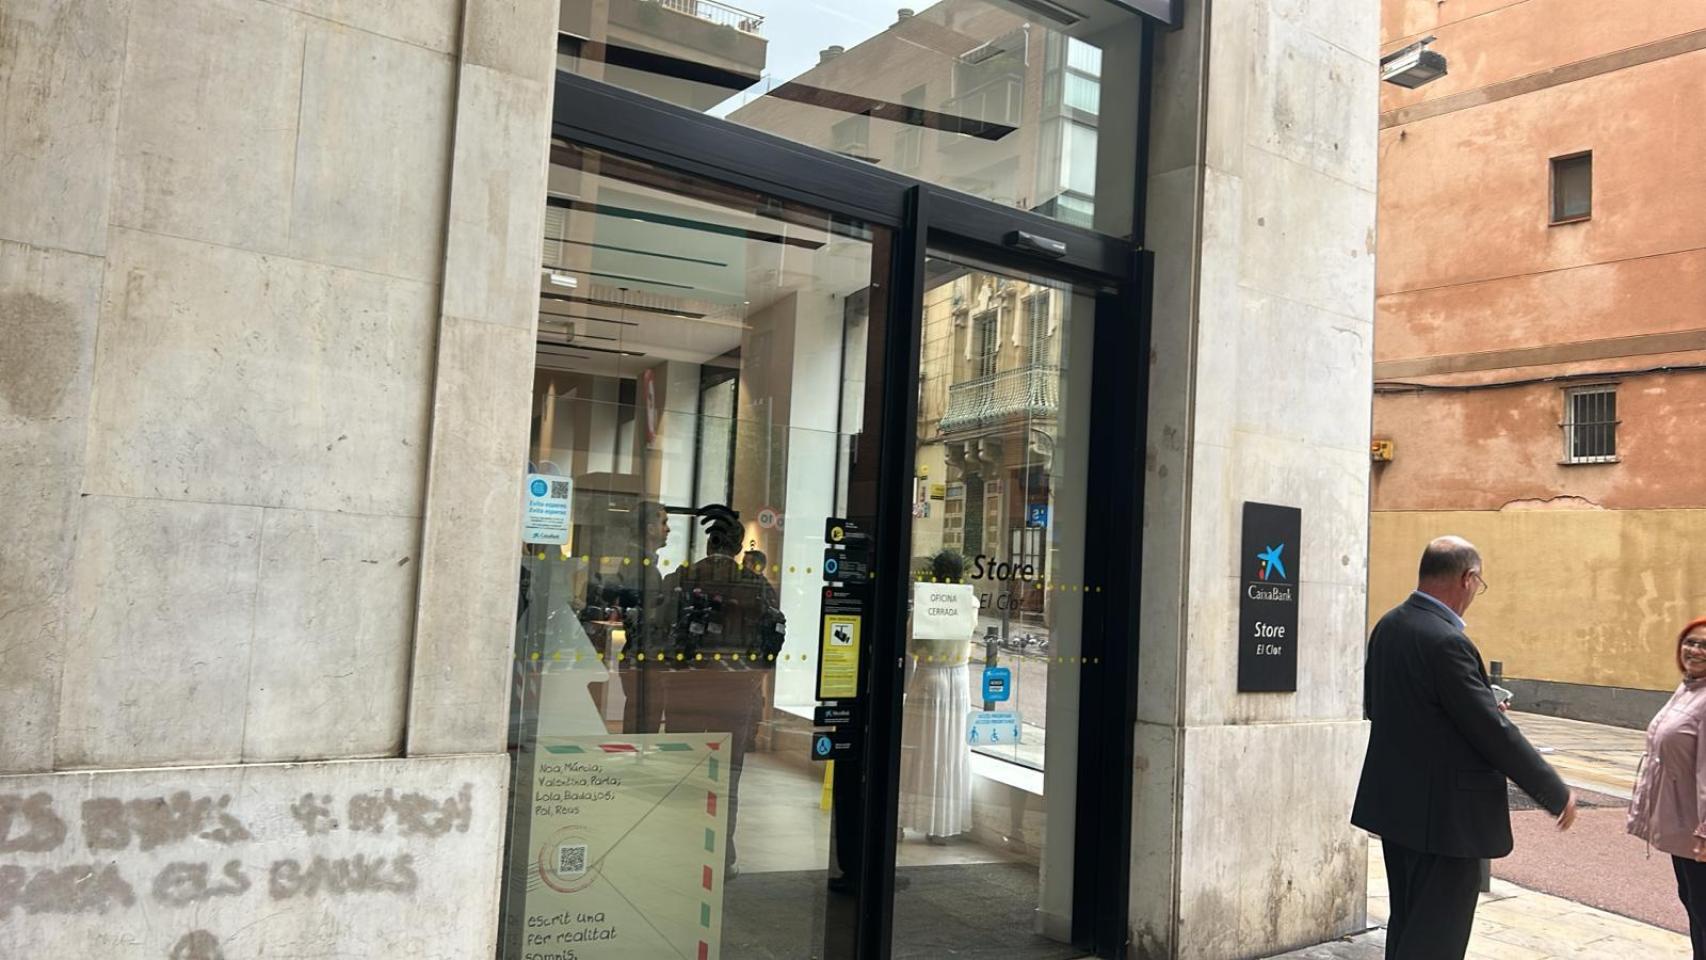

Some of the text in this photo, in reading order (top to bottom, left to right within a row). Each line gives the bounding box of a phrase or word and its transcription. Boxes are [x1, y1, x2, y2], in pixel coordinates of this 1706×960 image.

[971, 554, 1034, 582] Store
[930, 593, 957, 603] OFICINA
[1248, 584, 1292, 601] CaixaBank
[980, 593, 1025, 611] El Clot
[928, 607, 959, 617] CERRADA
[1254, 621, 1286, 638] Store
[1256, 644, 1282, 655] El Clot
[528, 911, 605, 927] escrit una
[528, 925, 617, 946] fer realitat
